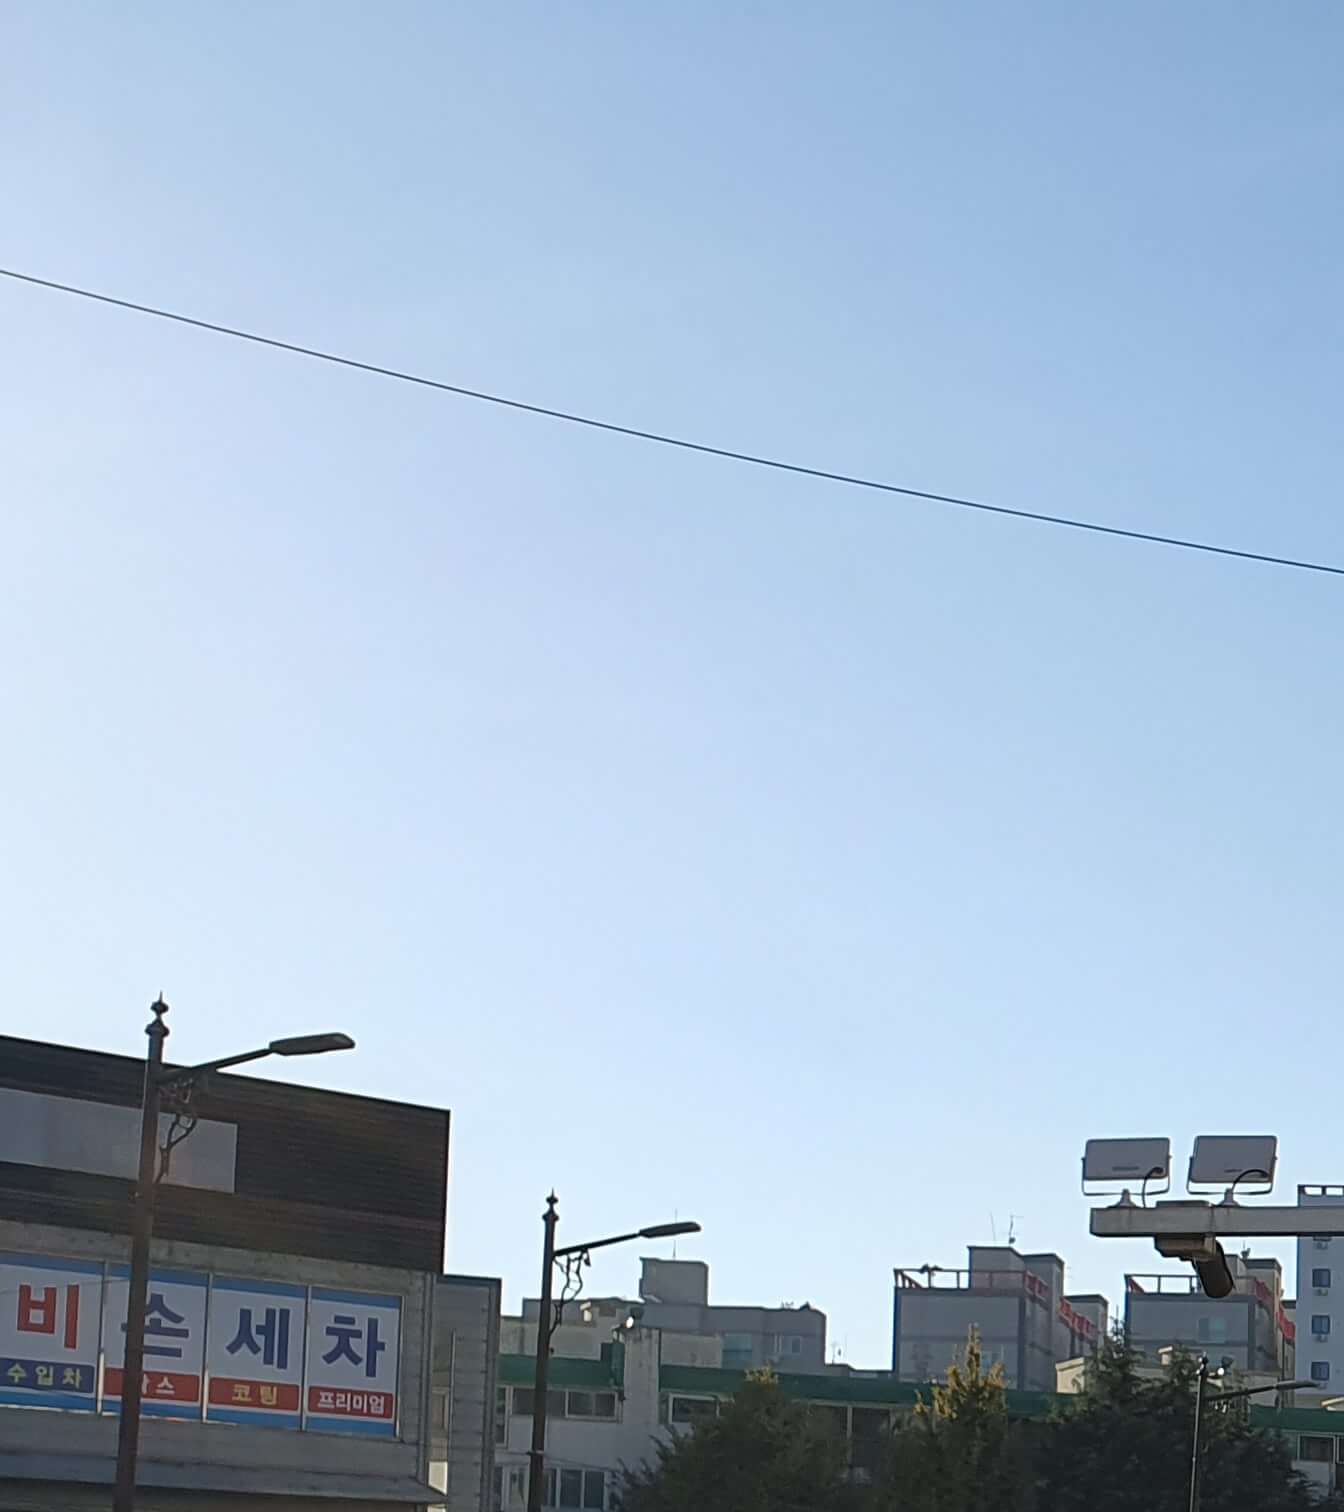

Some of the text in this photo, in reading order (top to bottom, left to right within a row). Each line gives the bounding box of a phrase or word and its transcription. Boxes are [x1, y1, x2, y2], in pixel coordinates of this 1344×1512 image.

[120, 1291, 387, 1379] 손세차
[5, 1360, 83, 1391] 수입차
[317, 1391, 386, 1415] 프리미엄
